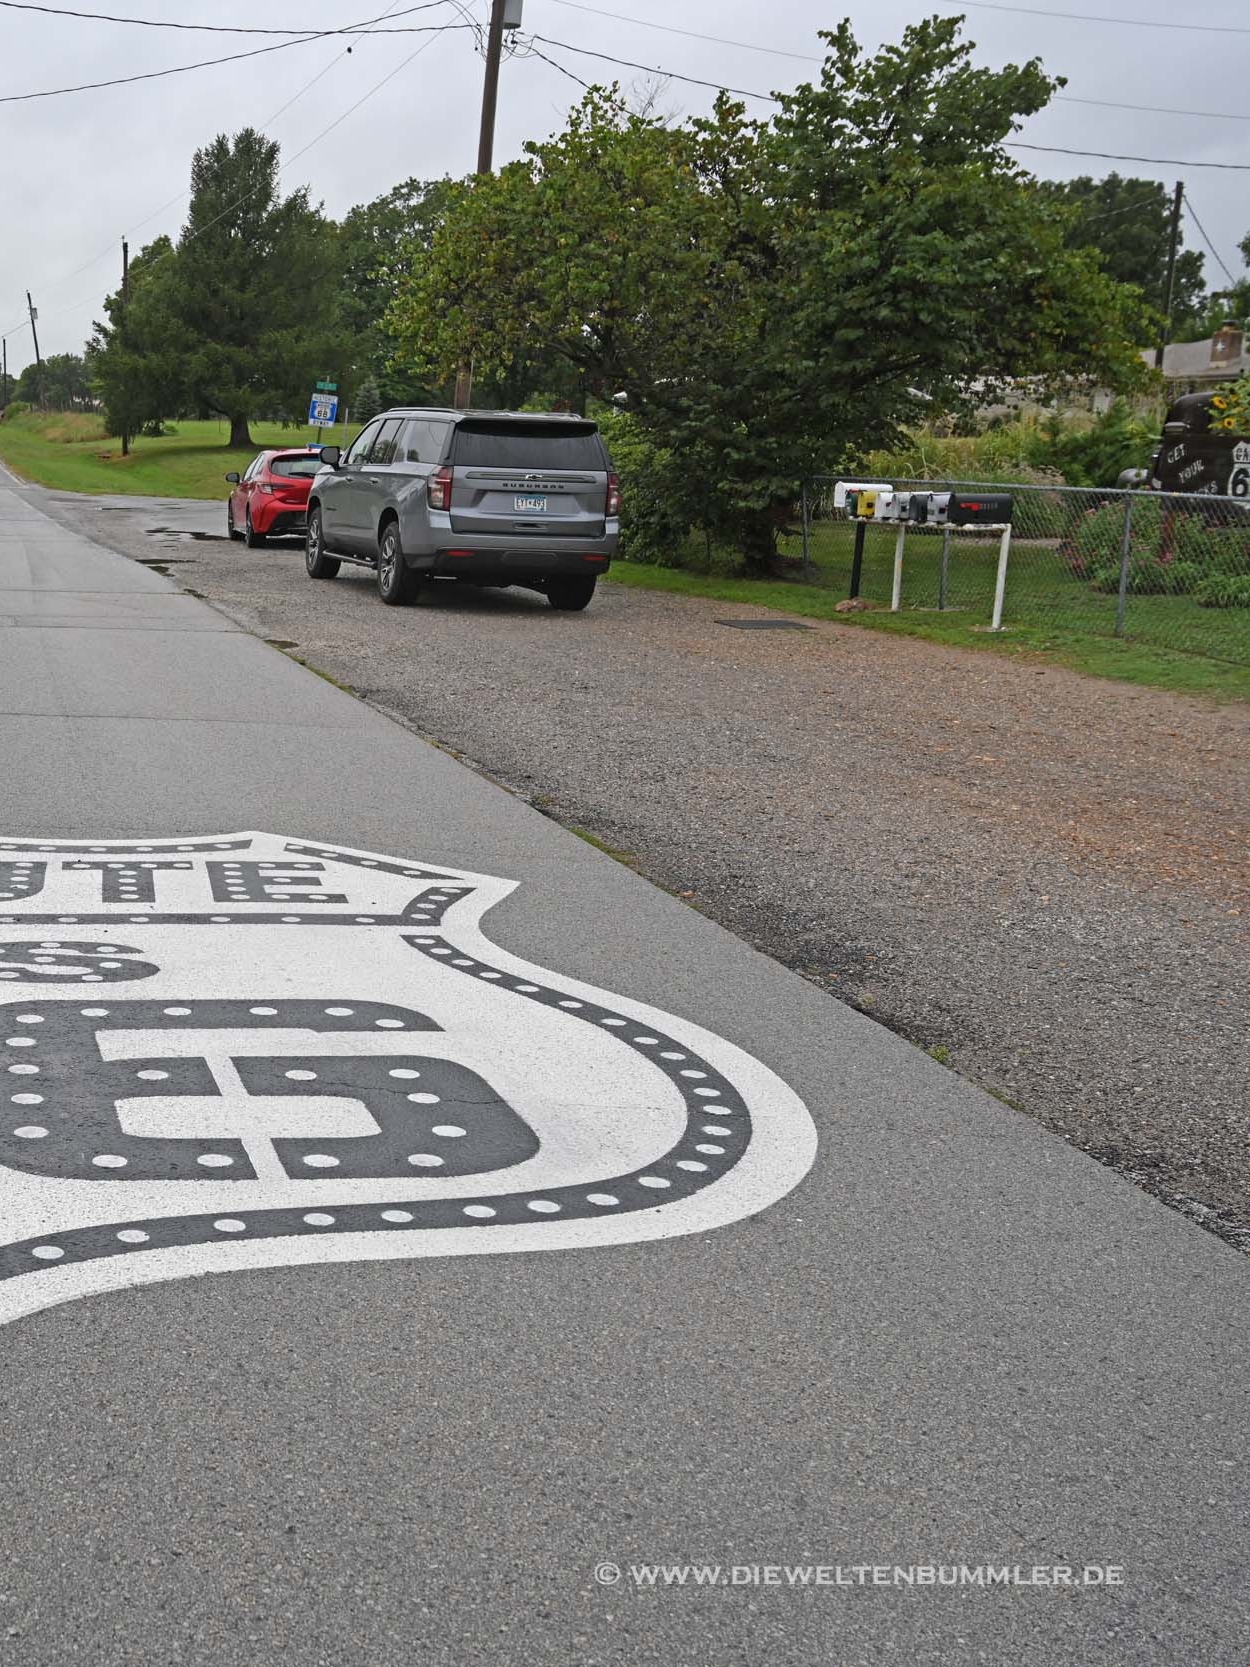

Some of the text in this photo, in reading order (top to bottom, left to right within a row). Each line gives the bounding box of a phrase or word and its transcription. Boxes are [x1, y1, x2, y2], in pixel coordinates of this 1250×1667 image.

[1167, 443, 1185, 464] GET
[1236, 447, 1250, 461] GA
[1178, 459, 1205, 484] YOUR
